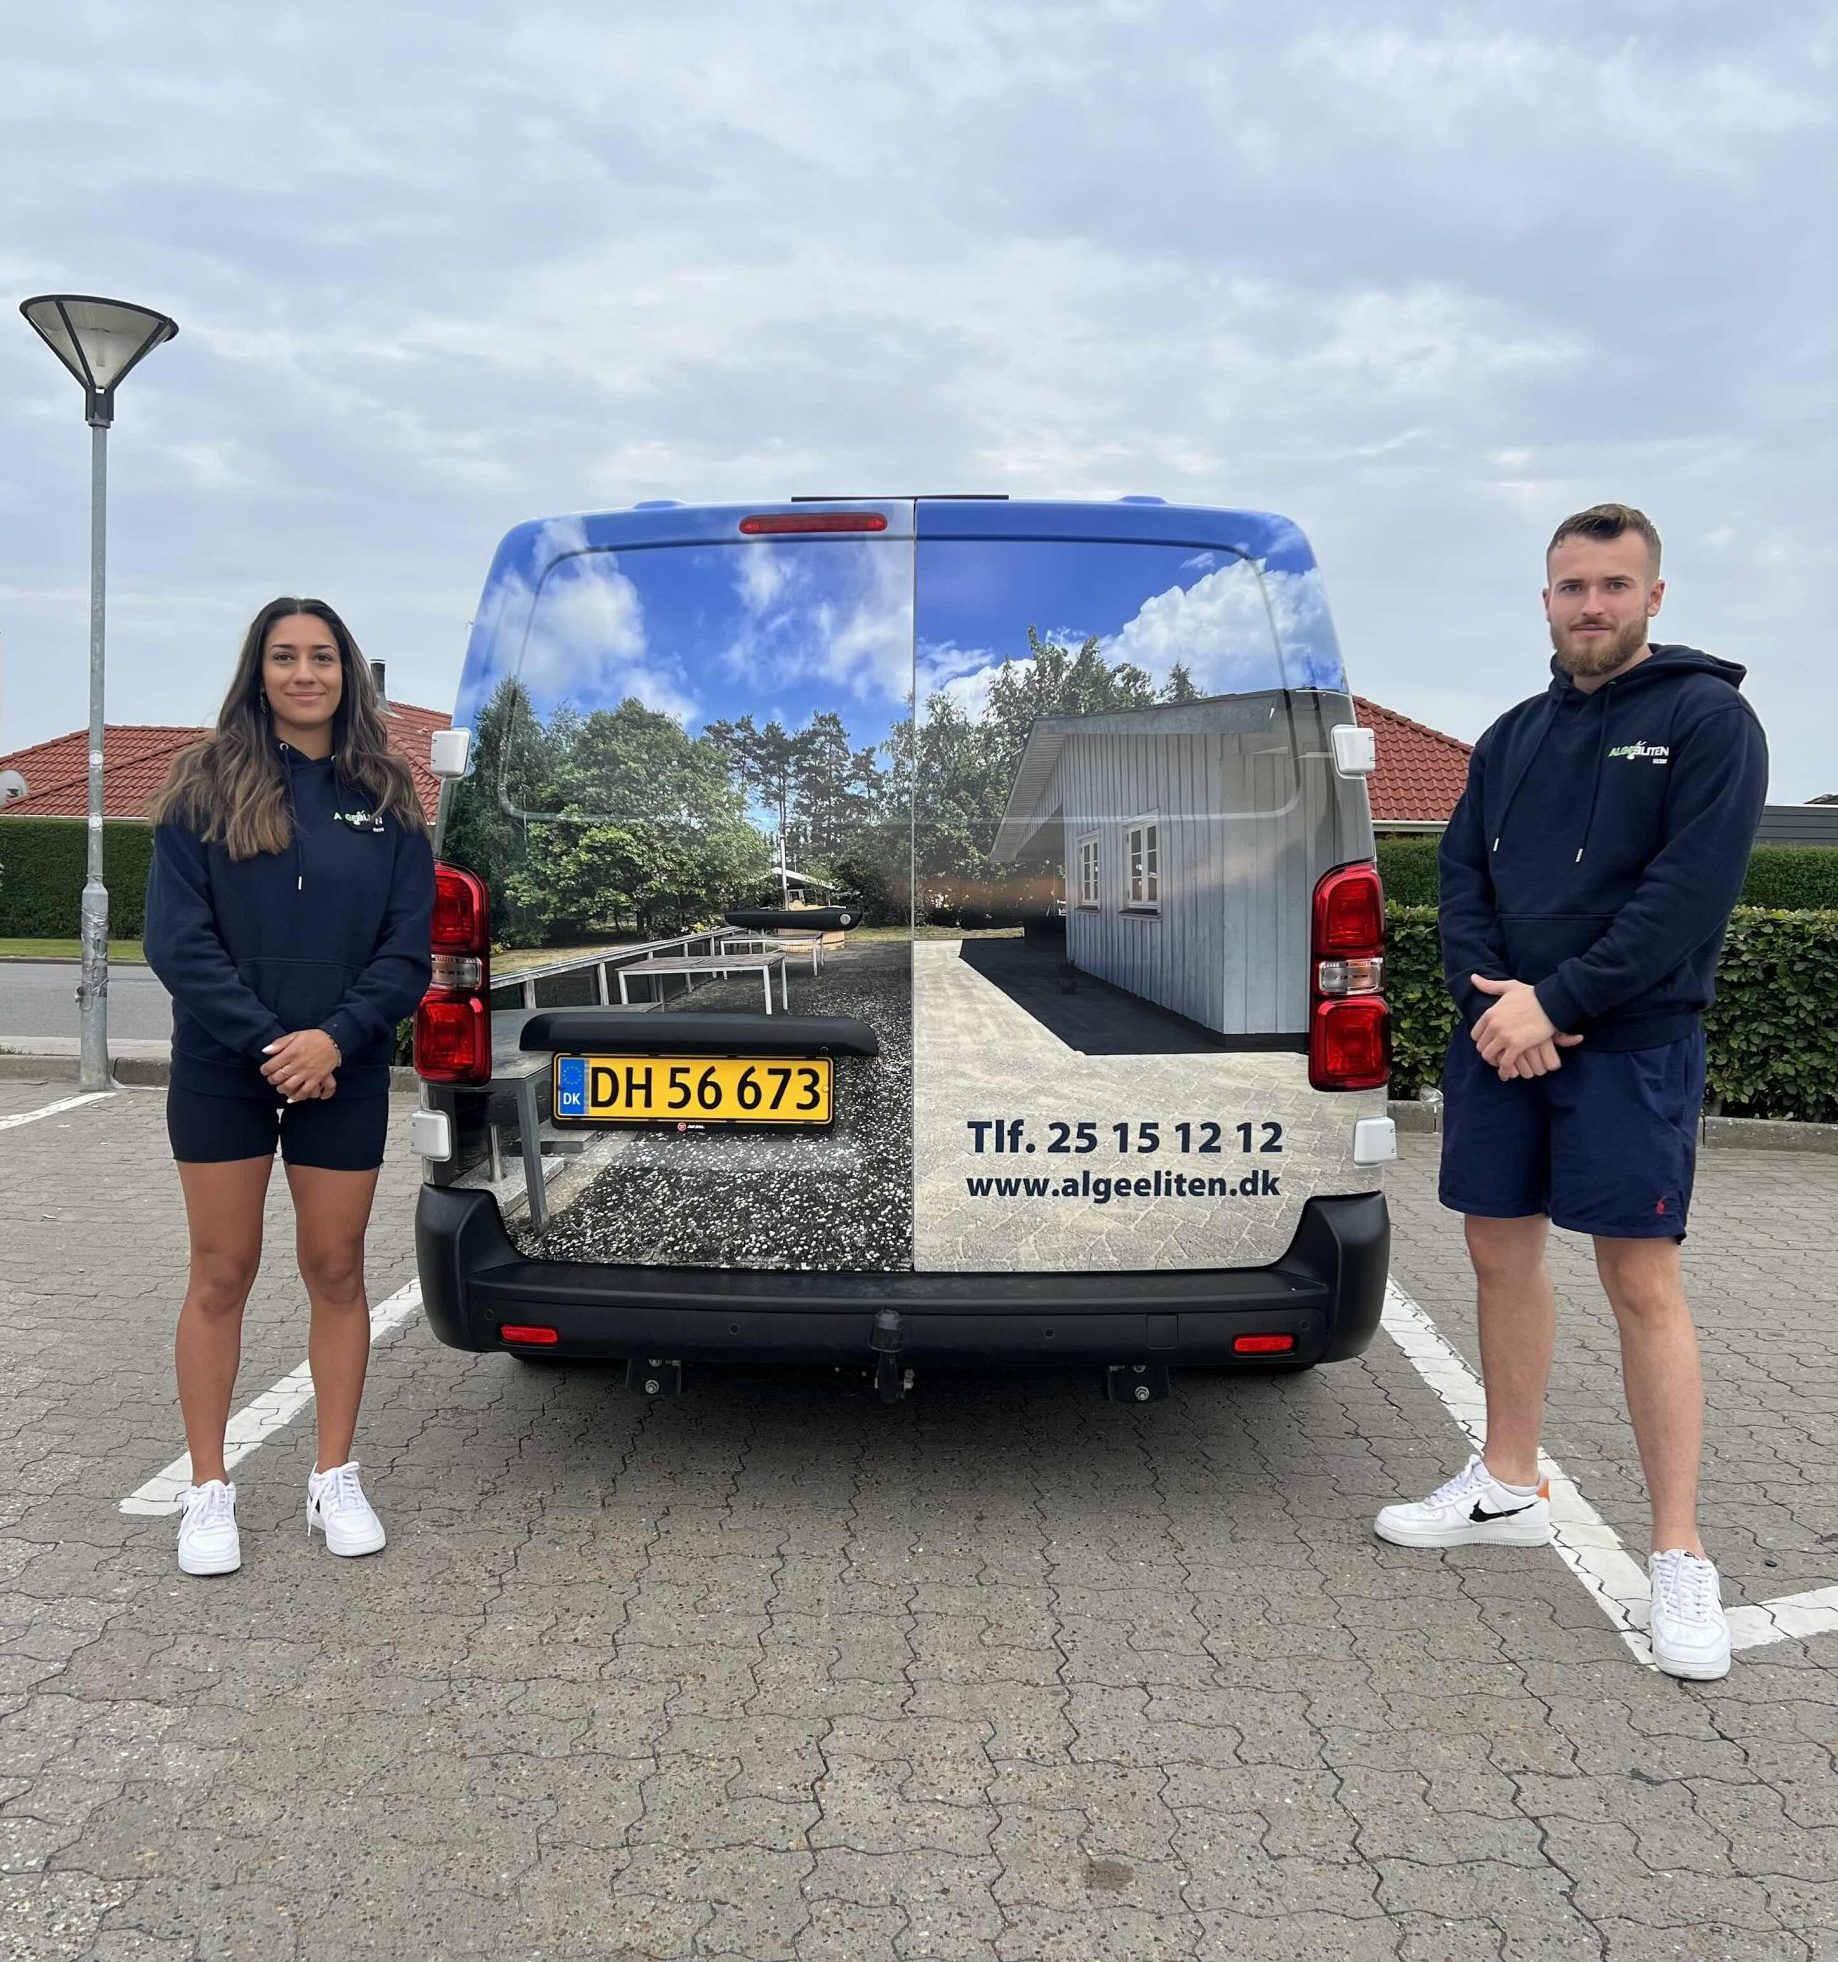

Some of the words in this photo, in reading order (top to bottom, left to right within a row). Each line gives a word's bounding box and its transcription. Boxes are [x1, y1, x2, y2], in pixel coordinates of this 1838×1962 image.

[563, 1092, 581, 1106] DK
[591, 1066, 653, 1108] DH
[667, 1065, 723, 1110] 56
[737, 1065, 821, 1110] 673
[967, 1119, 1036, 1154] Tlf.
[1047, 1121, 1098, 1154] 25
[1112, 1122, 1160, 1154] 15
[1174, 1121, 1222, 1153] 12
[1236, 1121, 1283, 1153] 12
[966, 1170, 1281, 1204] www.algeeliten.dk
